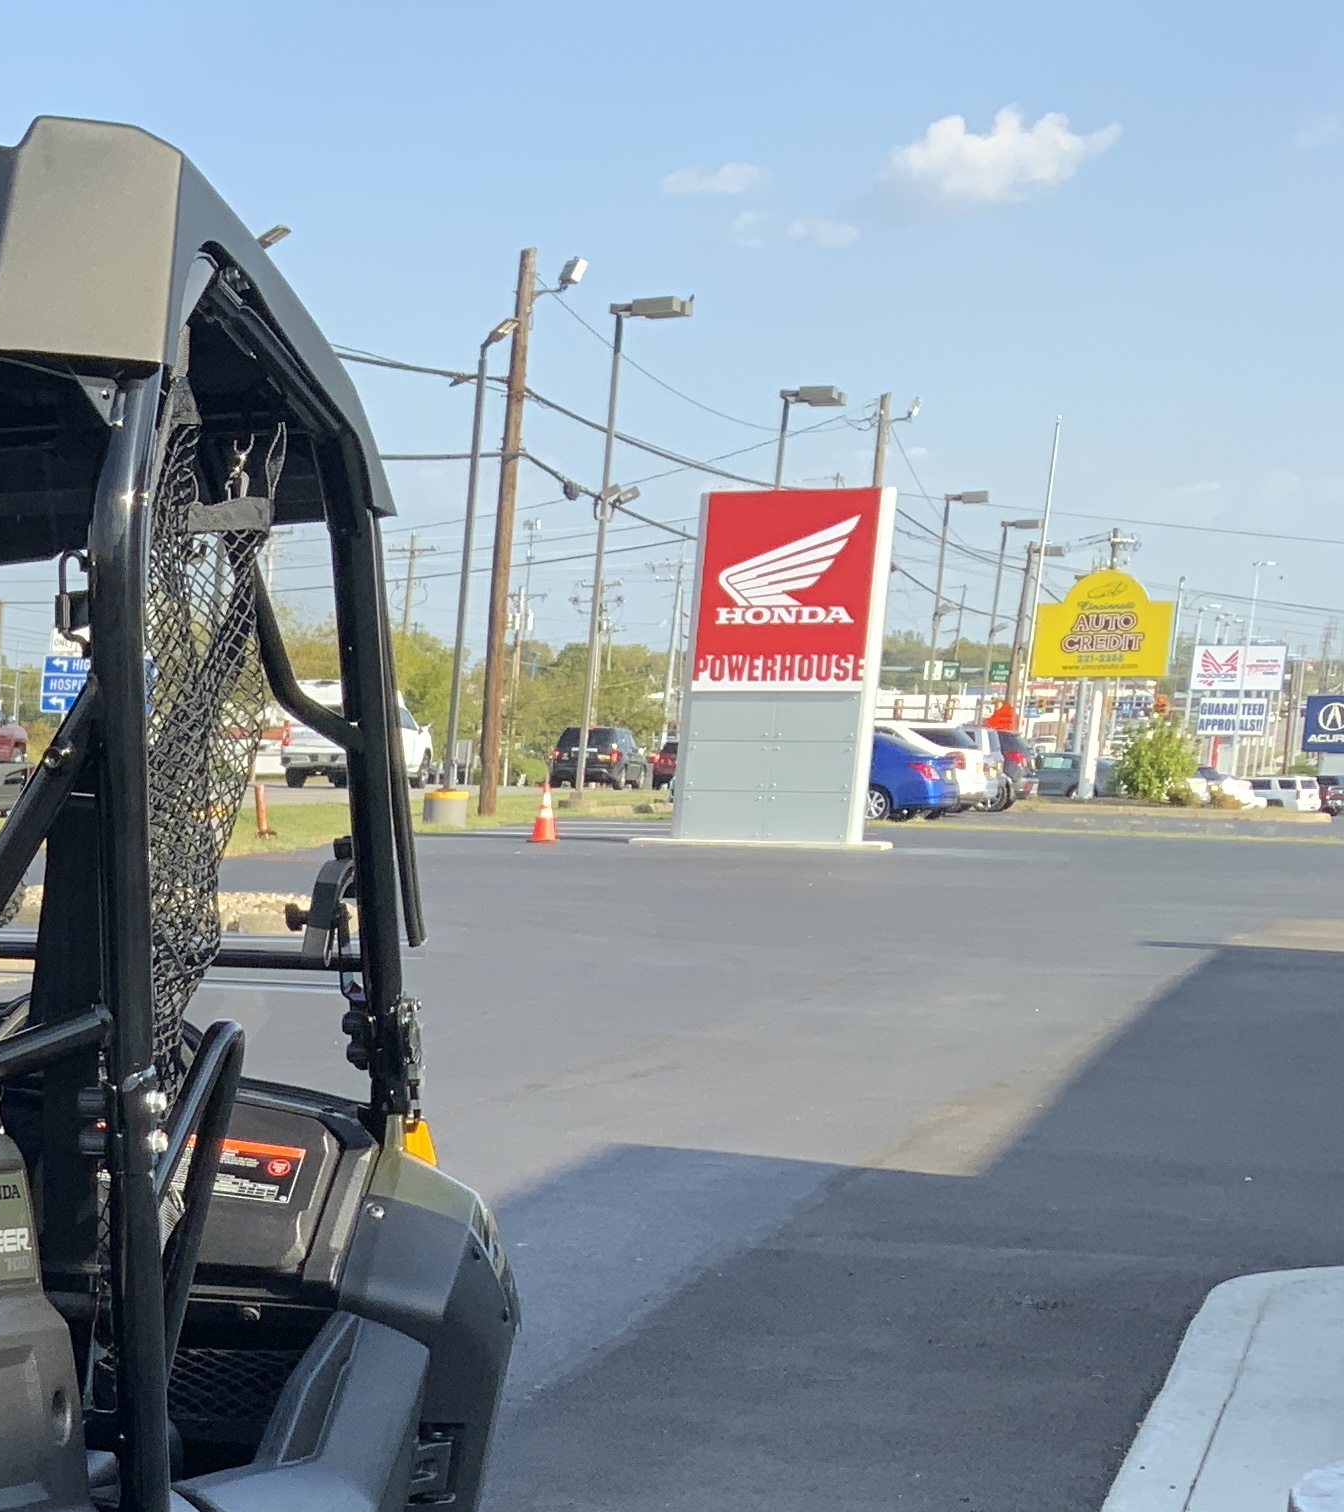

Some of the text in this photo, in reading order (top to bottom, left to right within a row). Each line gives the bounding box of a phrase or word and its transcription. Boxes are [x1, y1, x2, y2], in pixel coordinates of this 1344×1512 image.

[715, 606, 855, 625] HONDA
[1071, 612, 1138, 632] AUTO
[1060, 632, 1146, 653] CREDIT
[72, 658, 91, 671] HIG
[692, 654, 865, 682] POWERHOUSE
[49, 677, 86, 691] HOSPI
[1307, 733, 1344, 743] ACUR
[3, 1255, 30, 1273] 700
